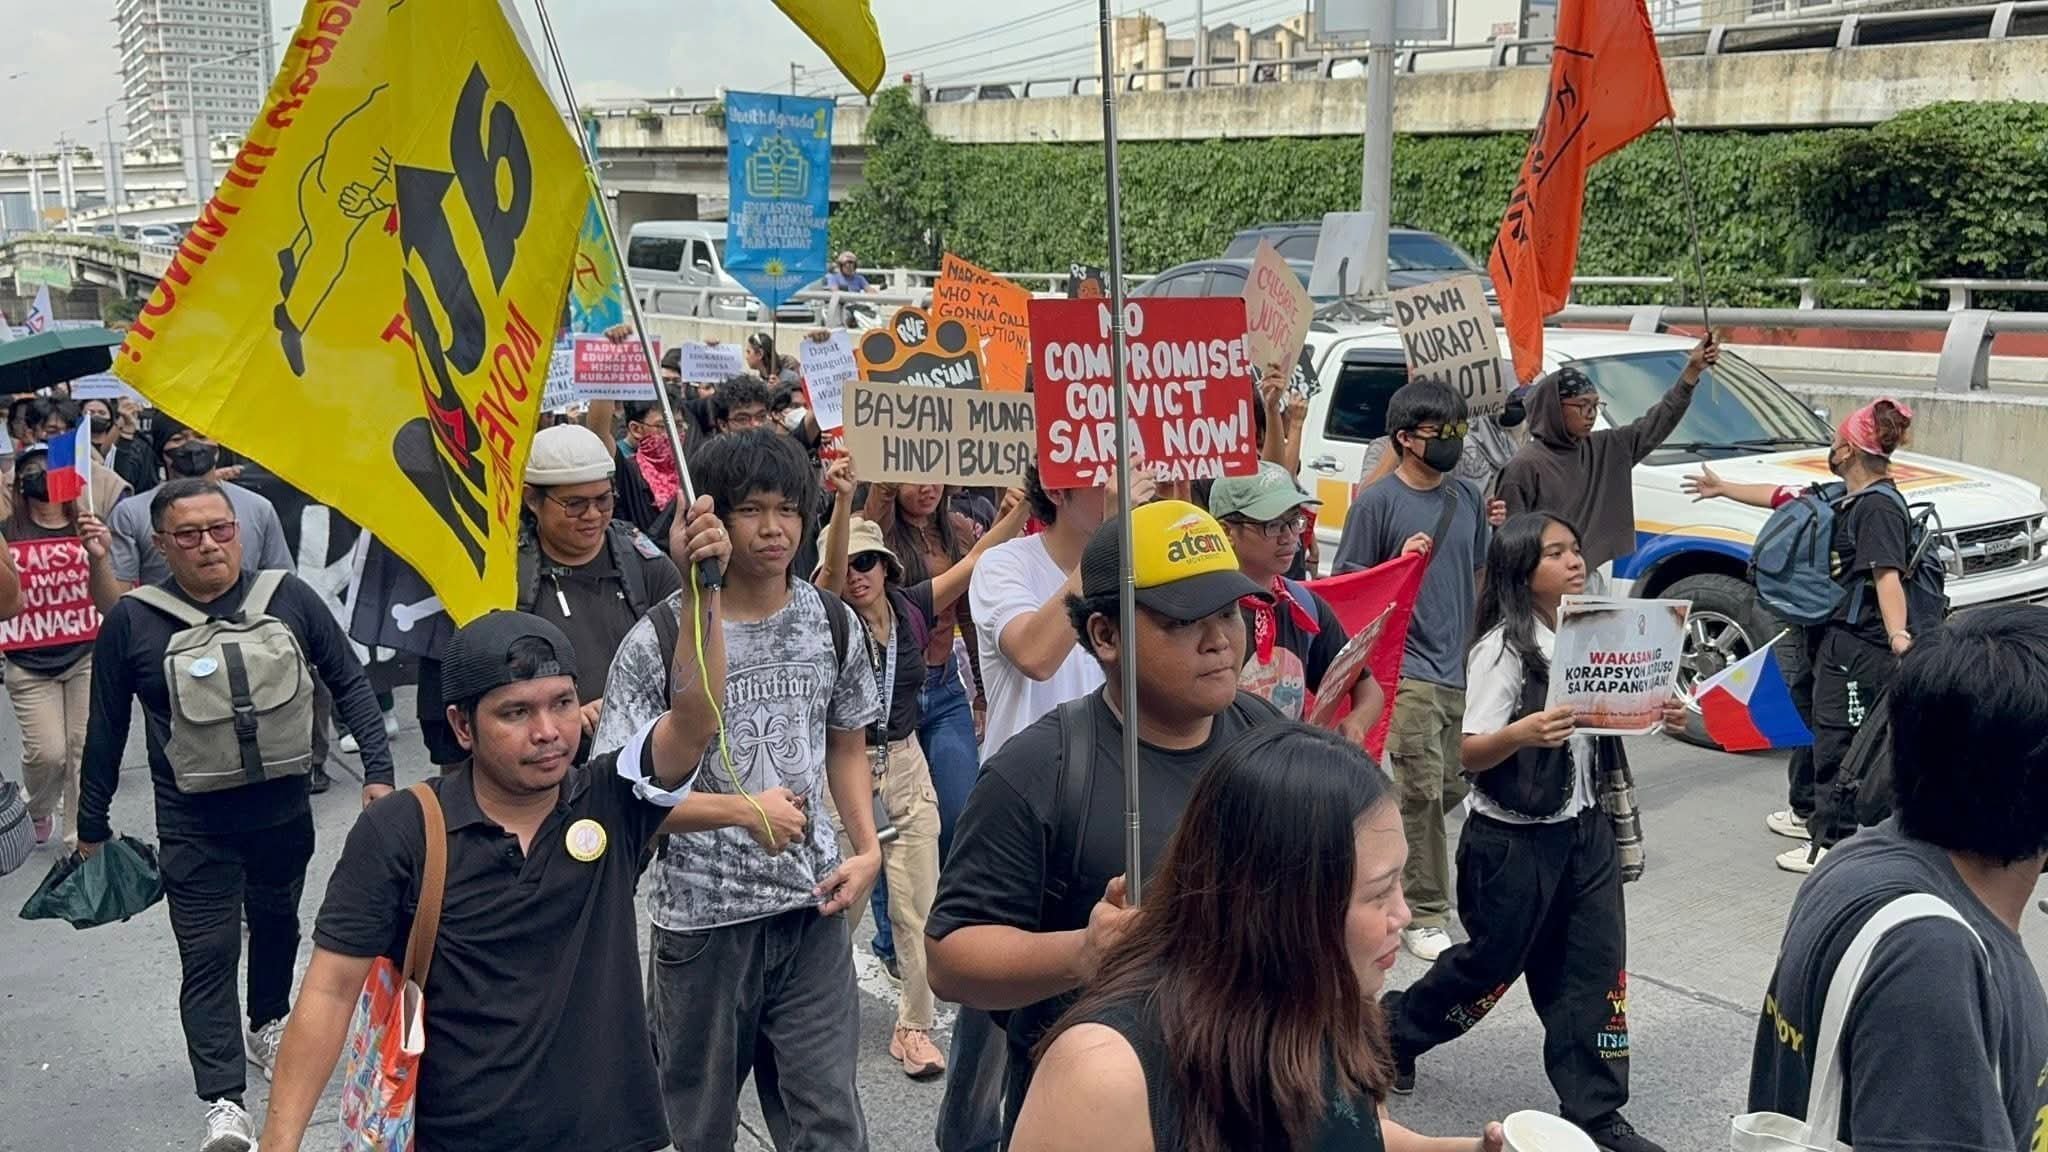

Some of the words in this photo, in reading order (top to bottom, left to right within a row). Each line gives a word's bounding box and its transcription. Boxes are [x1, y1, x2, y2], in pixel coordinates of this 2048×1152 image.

[939, 285, 971, 302] WHO
[978, 291, 1001, 307] YA
[939, 303, 996, 322] GONNA
[1395, 287, 1466, 327] DPWH
[1098, 303, 1144, 338] NO
[808, 342, 840, 358] Dapat
[1045, 333, 1252, 382] COMROMISE!
[1404, 316, 1489, 369] KURAP!
[855, 388, 953, 433] BAYAN
[967, 397, 1034, 434] MUNA
[1049, 418, 1146, 464] SARA
[1162, 399, 1250, 457] NOW!
[883, 435, 950, 476] HINDI
[958, 437, 1030, 477] BULSA
[1167, 531, 1227, 563] atom
[725, 670, 811, 710] ffliction
[1568, 682, 1581, 695] SA
